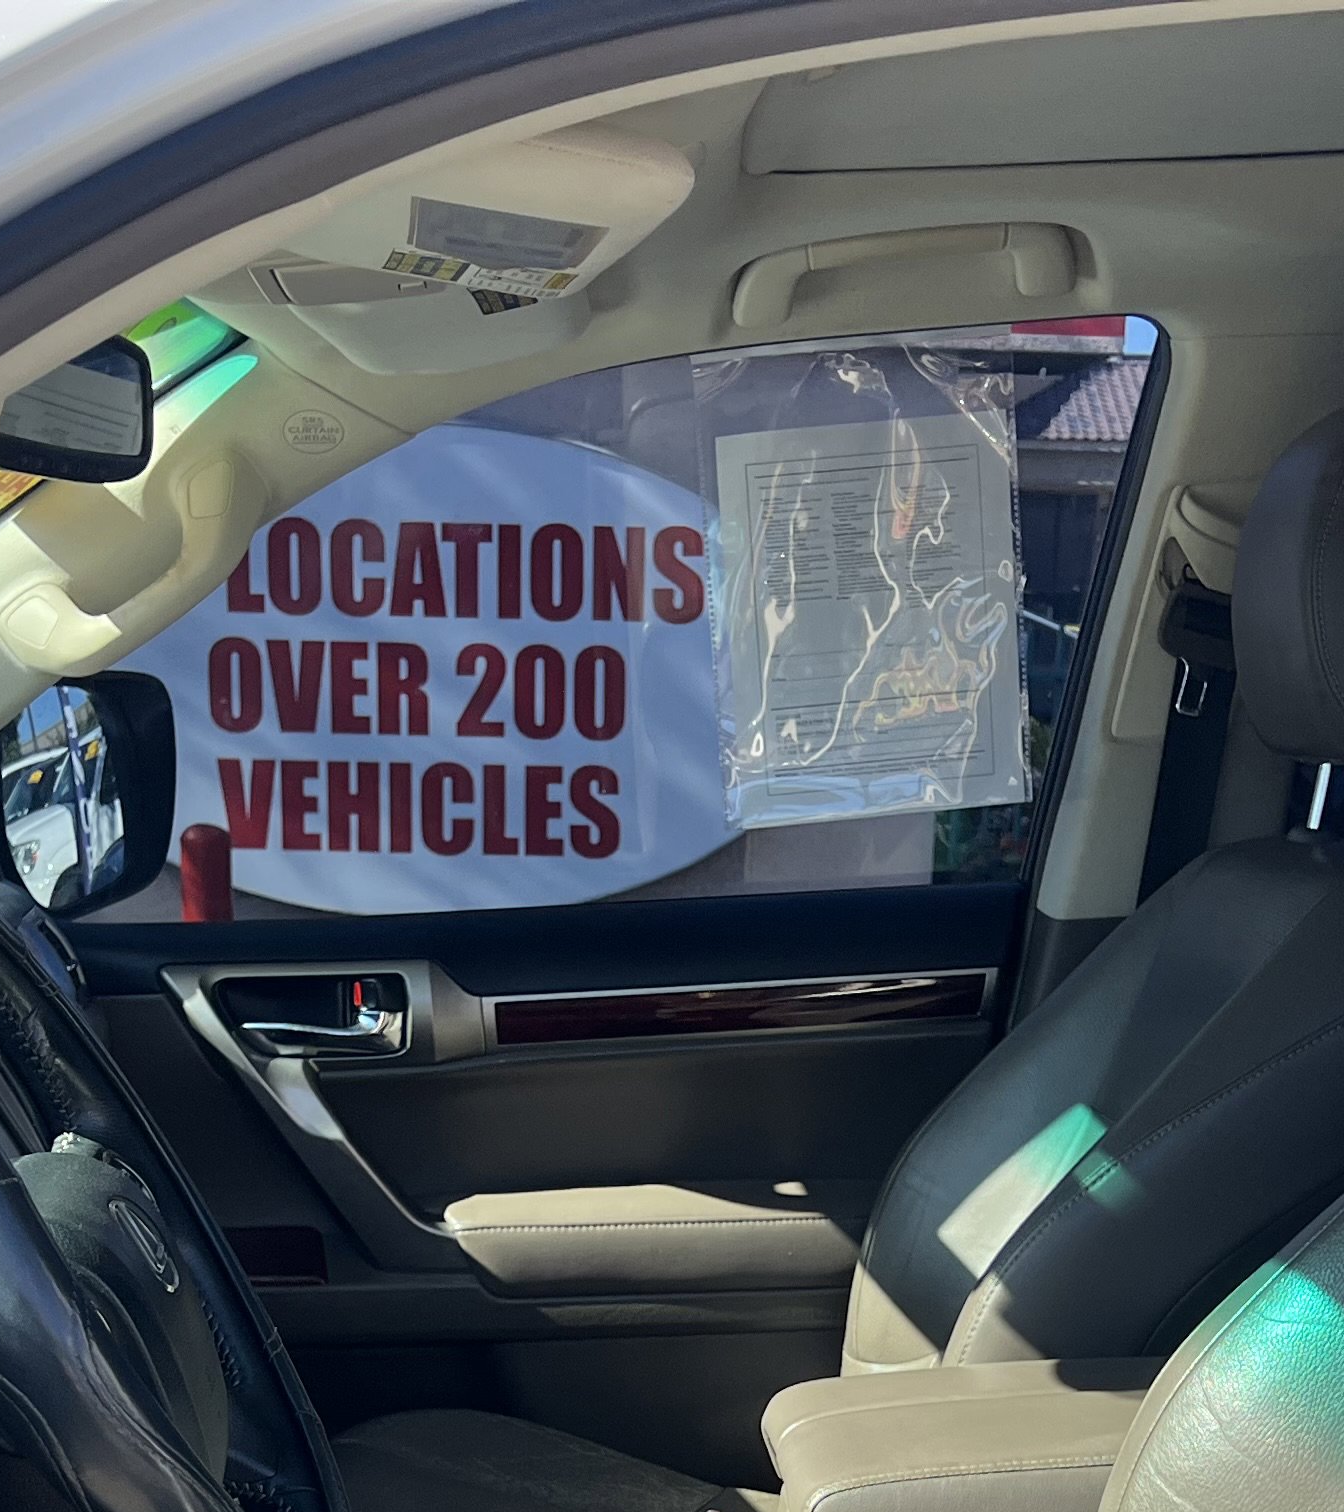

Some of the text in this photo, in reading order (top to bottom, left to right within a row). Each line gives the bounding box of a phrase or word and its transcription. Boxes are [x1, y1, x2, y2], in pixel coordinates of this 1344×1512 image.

[227, 516, 705, 625] LOCATIONS
[207, 636, 627, 742] OVER 200
[217, 758, 621, 860] VEHICLES
